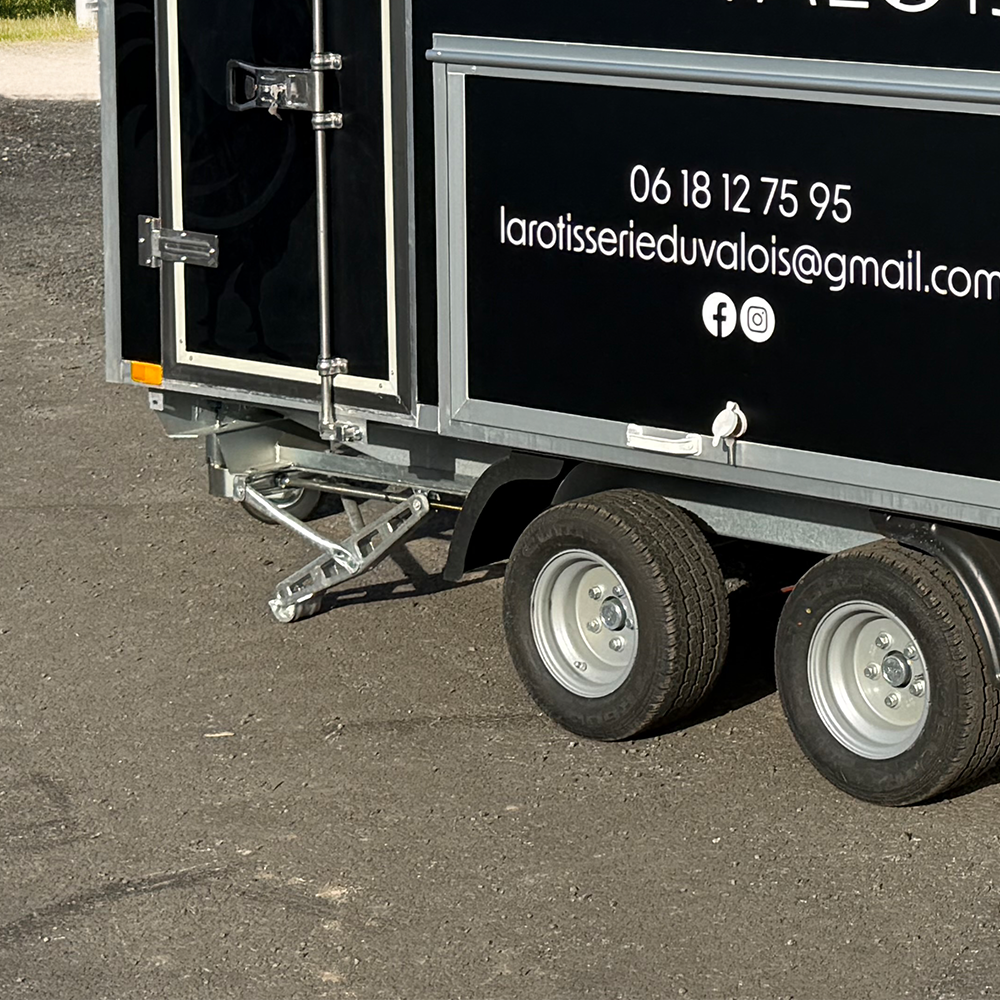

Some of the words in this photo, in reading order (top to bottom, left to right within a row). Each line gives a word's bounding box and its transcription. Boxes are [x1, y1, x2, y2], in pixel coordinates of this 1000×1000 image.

[630, 164, 671, 205] 06
[681, 169, 711, 209] 18
[722, 173, 751, 213] 12
[760, 176, 798, 218] 75
[809, 181, 852, 223] 95
